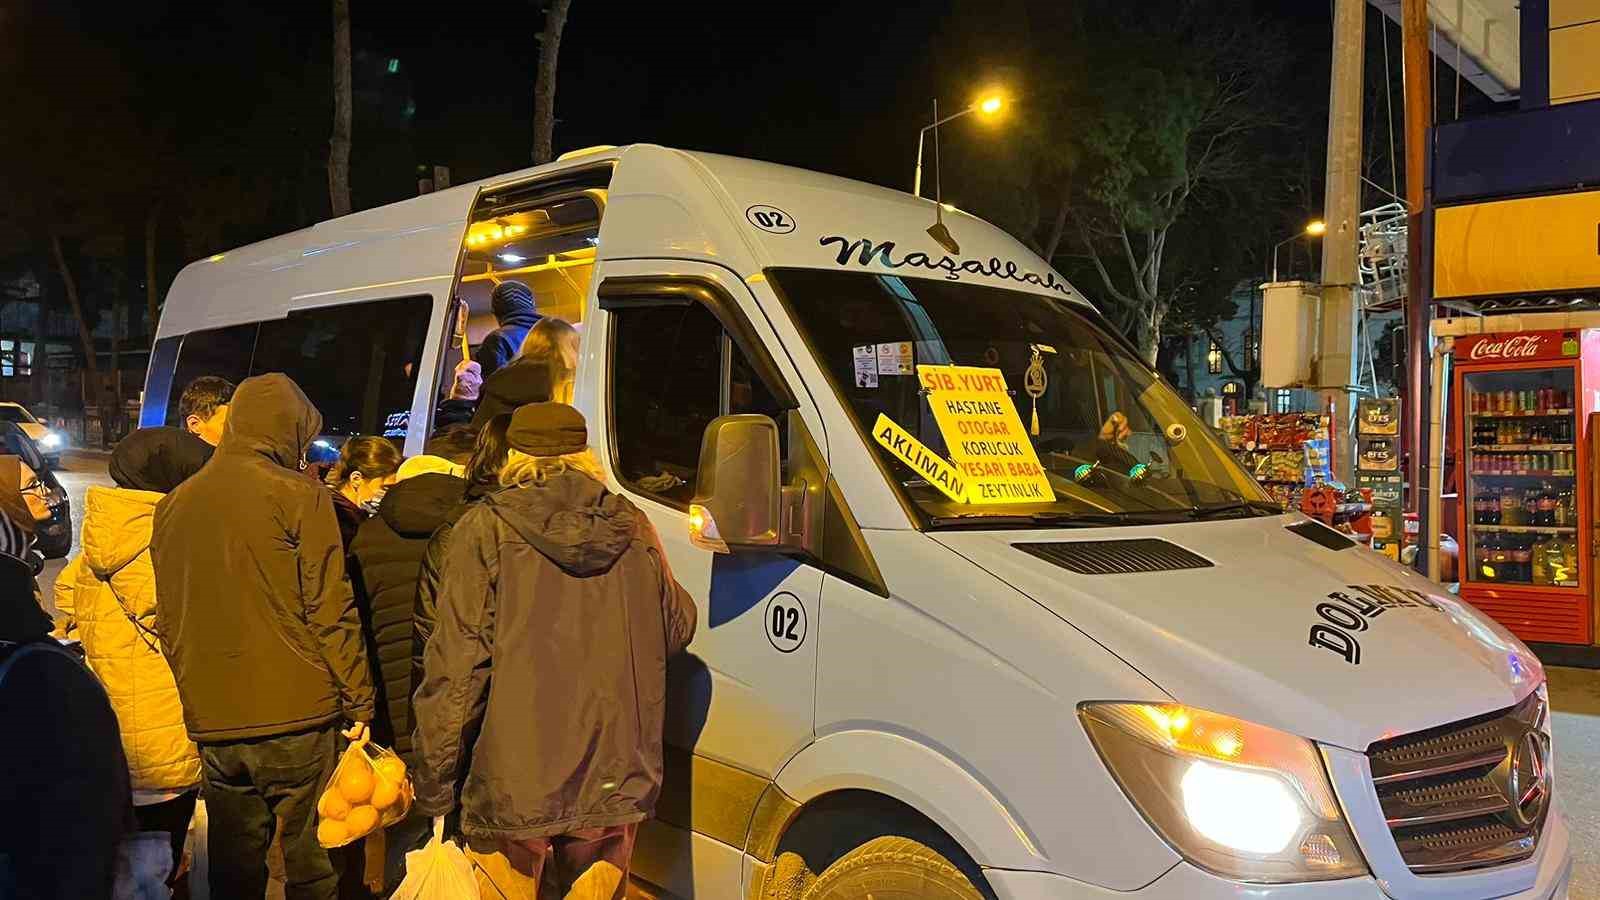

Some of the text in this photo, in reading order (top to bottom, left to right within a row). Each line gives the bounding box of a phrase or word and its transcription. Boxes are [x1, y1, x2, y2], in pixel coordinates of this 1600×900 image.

[753, 210, 791, 229] 02
[819, 236, 1071, 295] Maşallah
[945, 400, 1004, 415] HASTANE
[957, 420, 1011, 436] OTOGAR
[961, 440, 1024, 456] KORUCUK
[879, 427, 964, 497] AKLİMAN
[1007, 462, 1043, 477] BABA
[978, 480, 1045, 498] ZEYTİNLİK
[771, 604, 799, 641] 02
